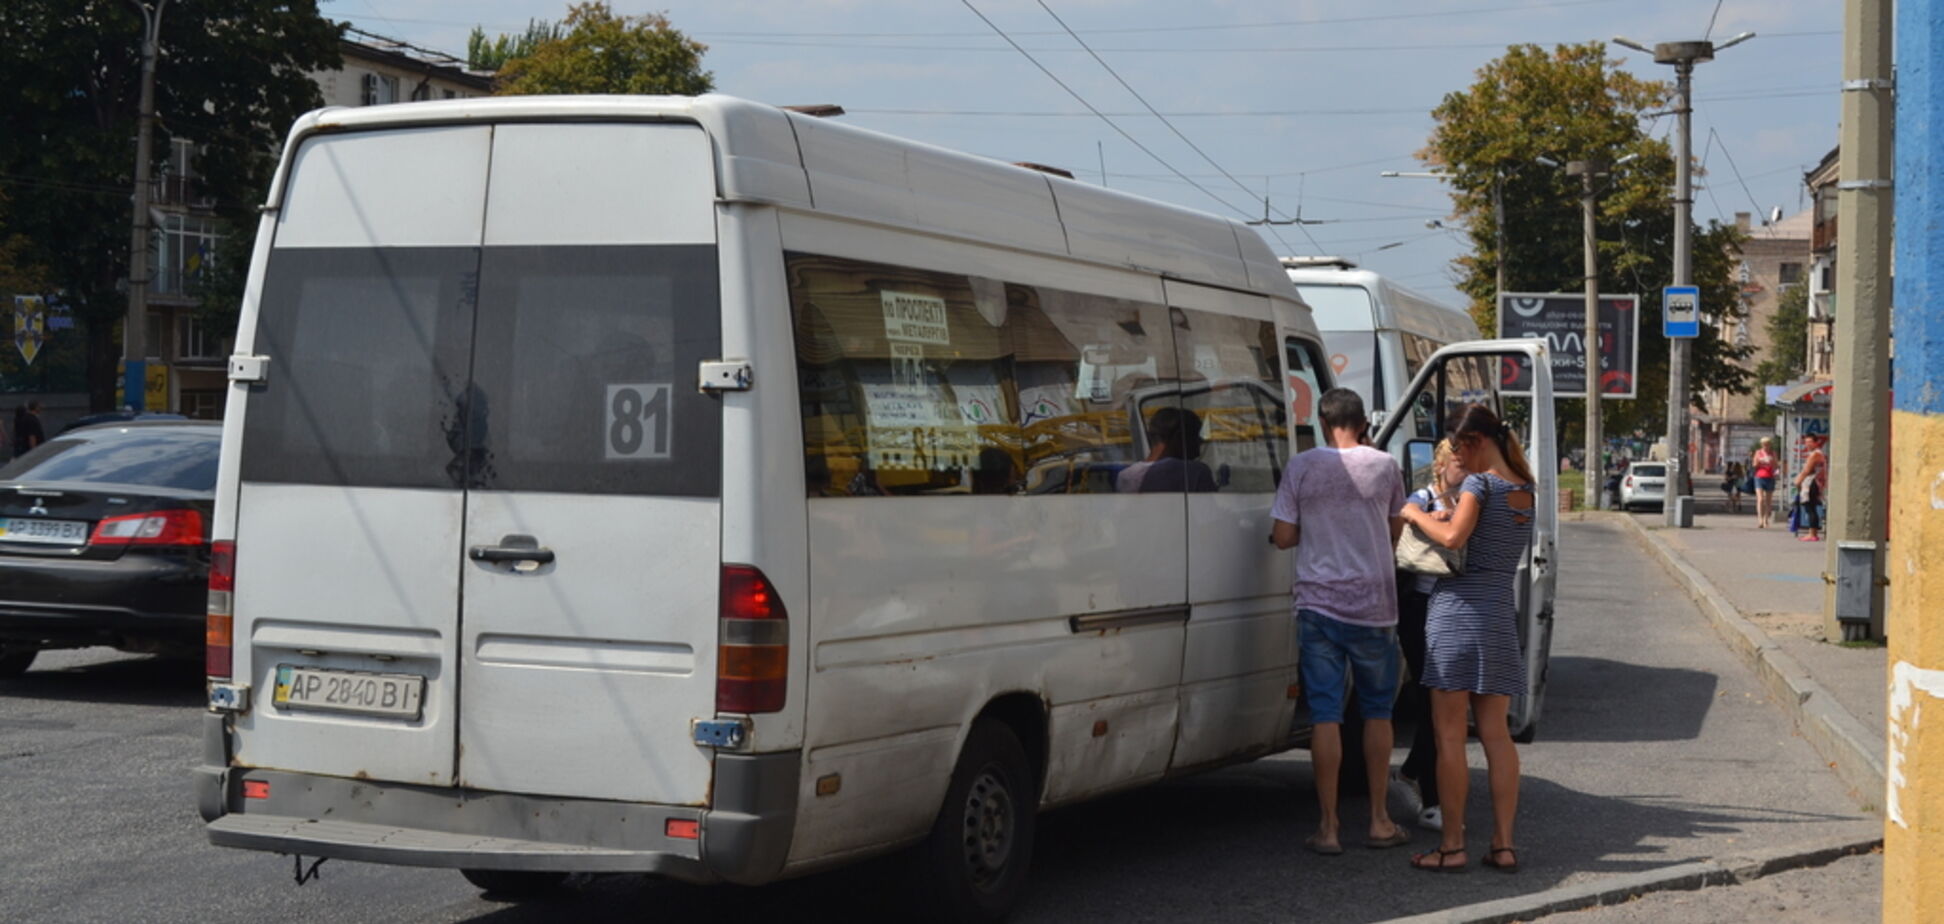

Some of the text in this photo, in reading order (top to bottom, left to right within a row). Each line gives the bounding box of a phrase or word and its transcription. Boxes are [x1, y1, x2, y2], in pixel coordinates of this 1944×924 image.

[895, 296, 944, 324] ПРОСПЕКТУ
[610, 387, 669, 456] 81
[289, 674, 409, 709] AP 2840 BI
